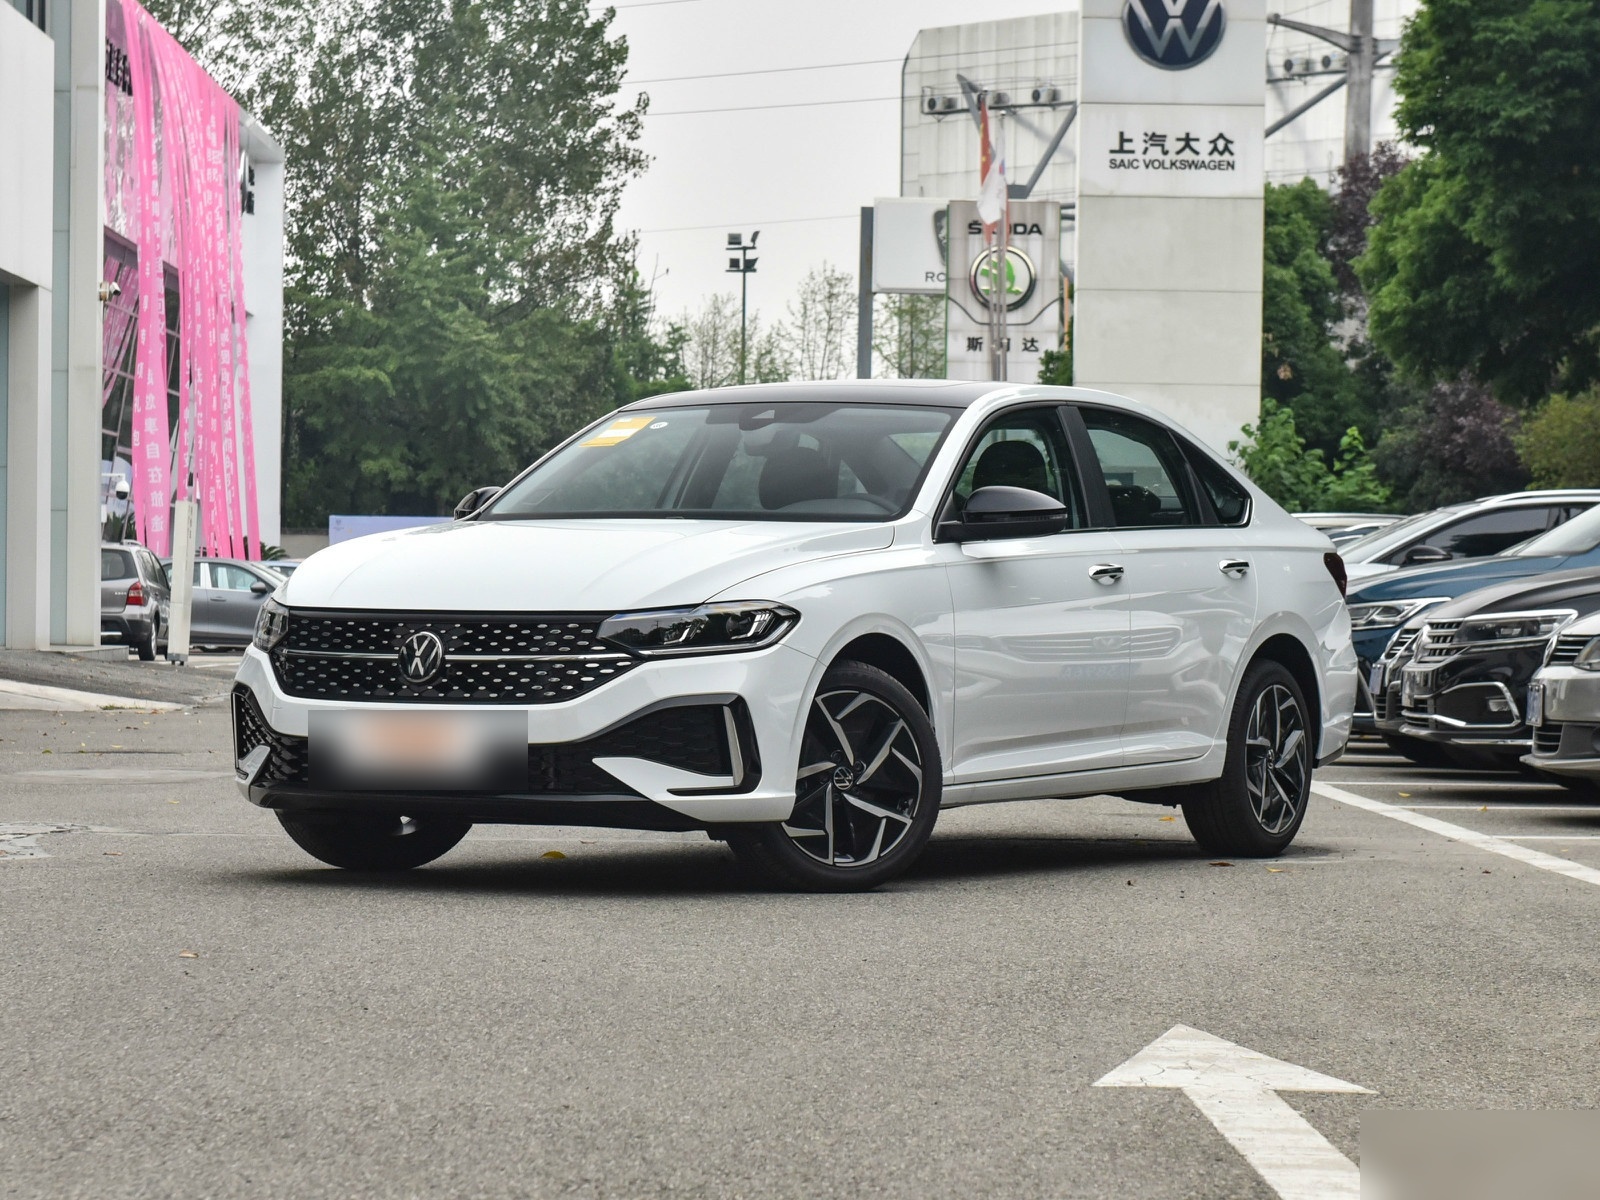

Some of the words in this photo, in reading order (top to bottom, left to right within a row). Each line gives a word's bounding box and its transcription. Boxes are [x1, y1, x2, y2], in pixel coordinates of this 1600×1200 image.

[1108, 131, 1235, 157] 上汽大众
[1108, 158, 1140, 170] SAIC
[1143, 158, 1236, 171] VOLKSWAGEN
